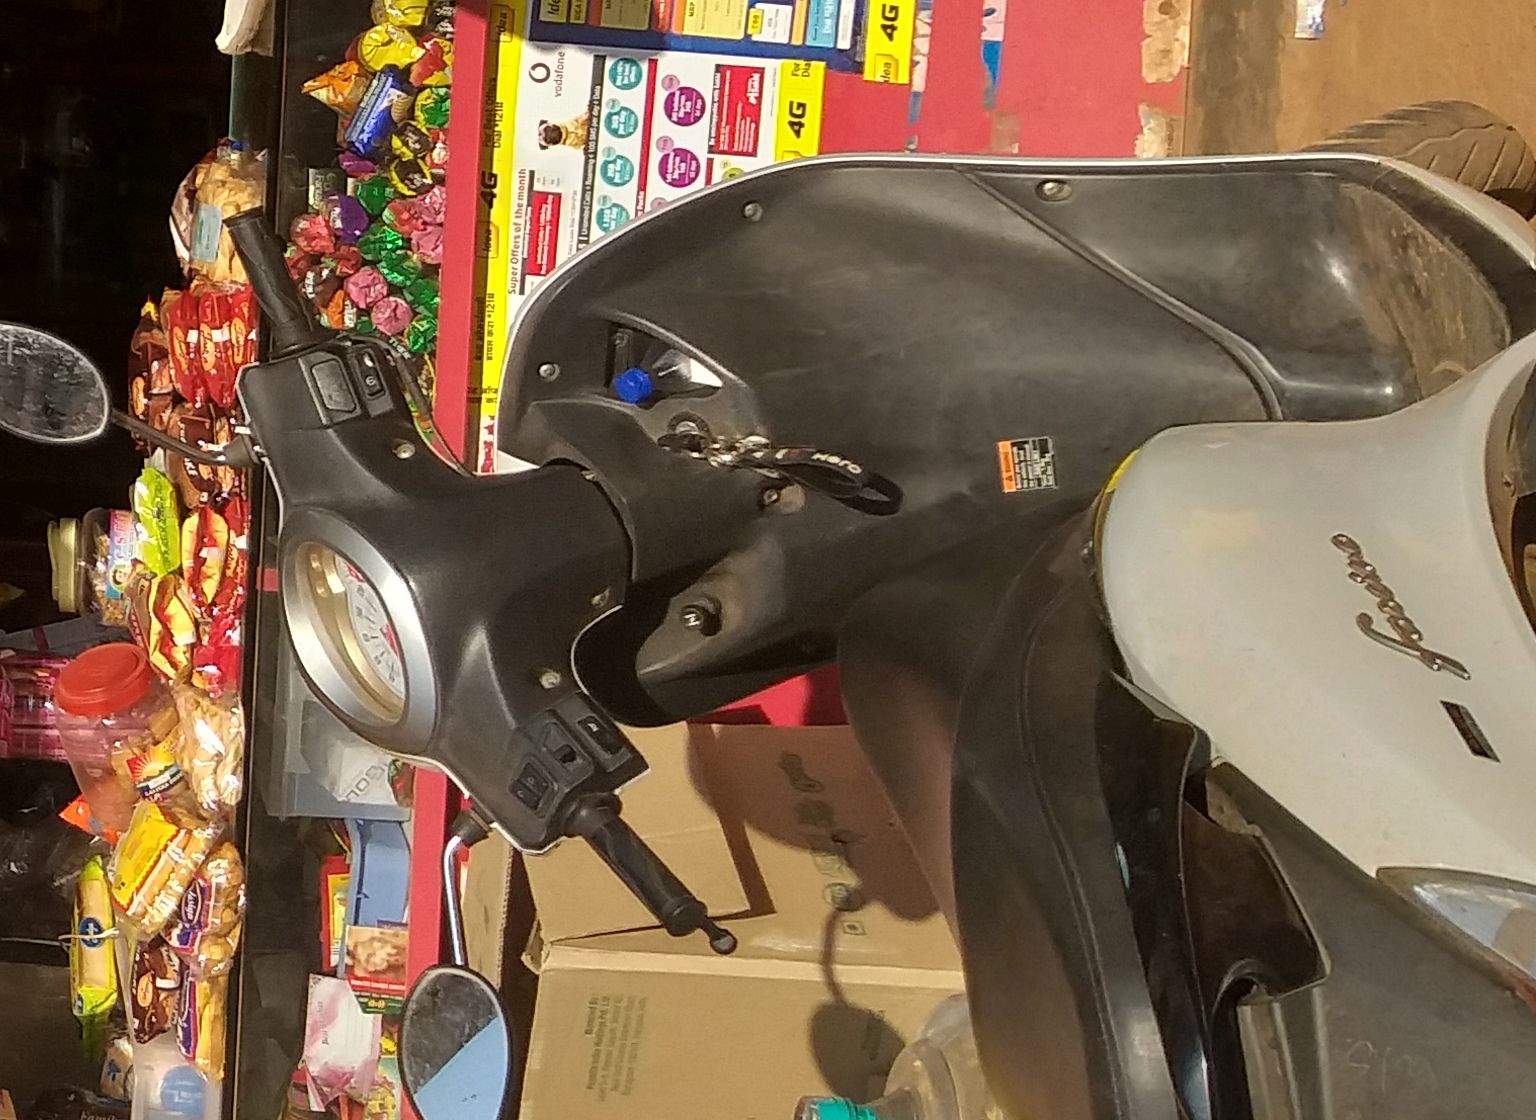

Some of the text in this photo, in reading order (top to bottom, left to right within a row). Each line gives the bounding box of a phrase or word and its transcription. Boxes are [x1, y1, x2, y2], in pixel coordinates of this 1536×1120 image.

[880, 3, 900, 42] 4G
[553, 51, 566, 98] vodafone
[791, 62, 801, 77] For
[786, 100, 807, 140] 4G
[508, 168, 527, 295] Super Offers of the month
